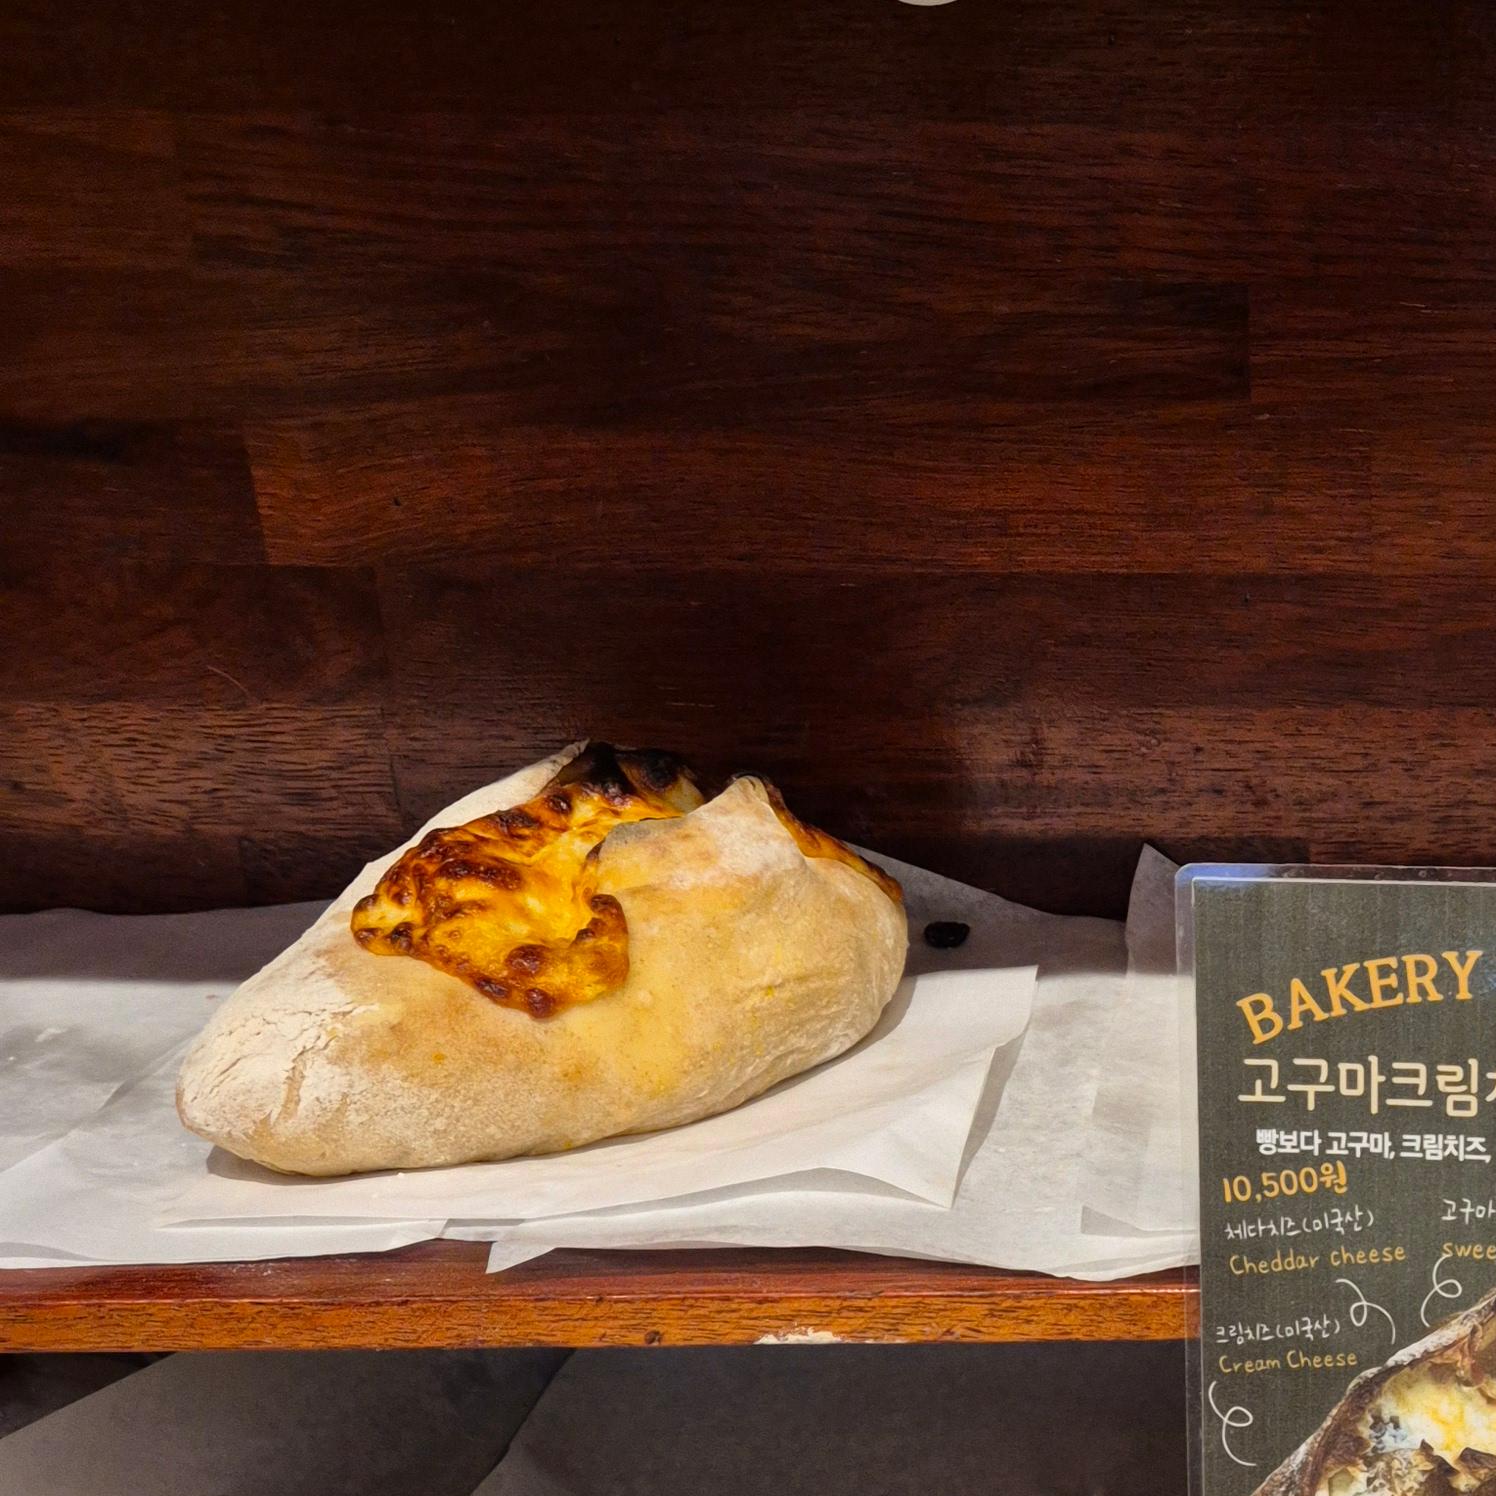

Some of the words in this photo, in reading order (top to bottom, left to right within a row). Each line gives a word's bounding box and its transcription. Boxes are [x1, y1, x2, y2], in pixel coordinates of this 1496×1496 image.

[1236, 950, 1483, 1045] BAKERY
[1256, 1129, 1322, 1155] 빵보다
[1326, 1131, 1395, 1160] 고구마,
[1401, 1133, 1491, 1163] 크림치즈,
[1222, 1160, 1349, 1203] 10,500원
[1229, 1247, 1320, 1276] Cheddar
[1330, 1245, 1407, 1267] cheese
[1218, 1354, 1282, 1374] Cream
[1286, 1349, 1359, 1370] Cheese
